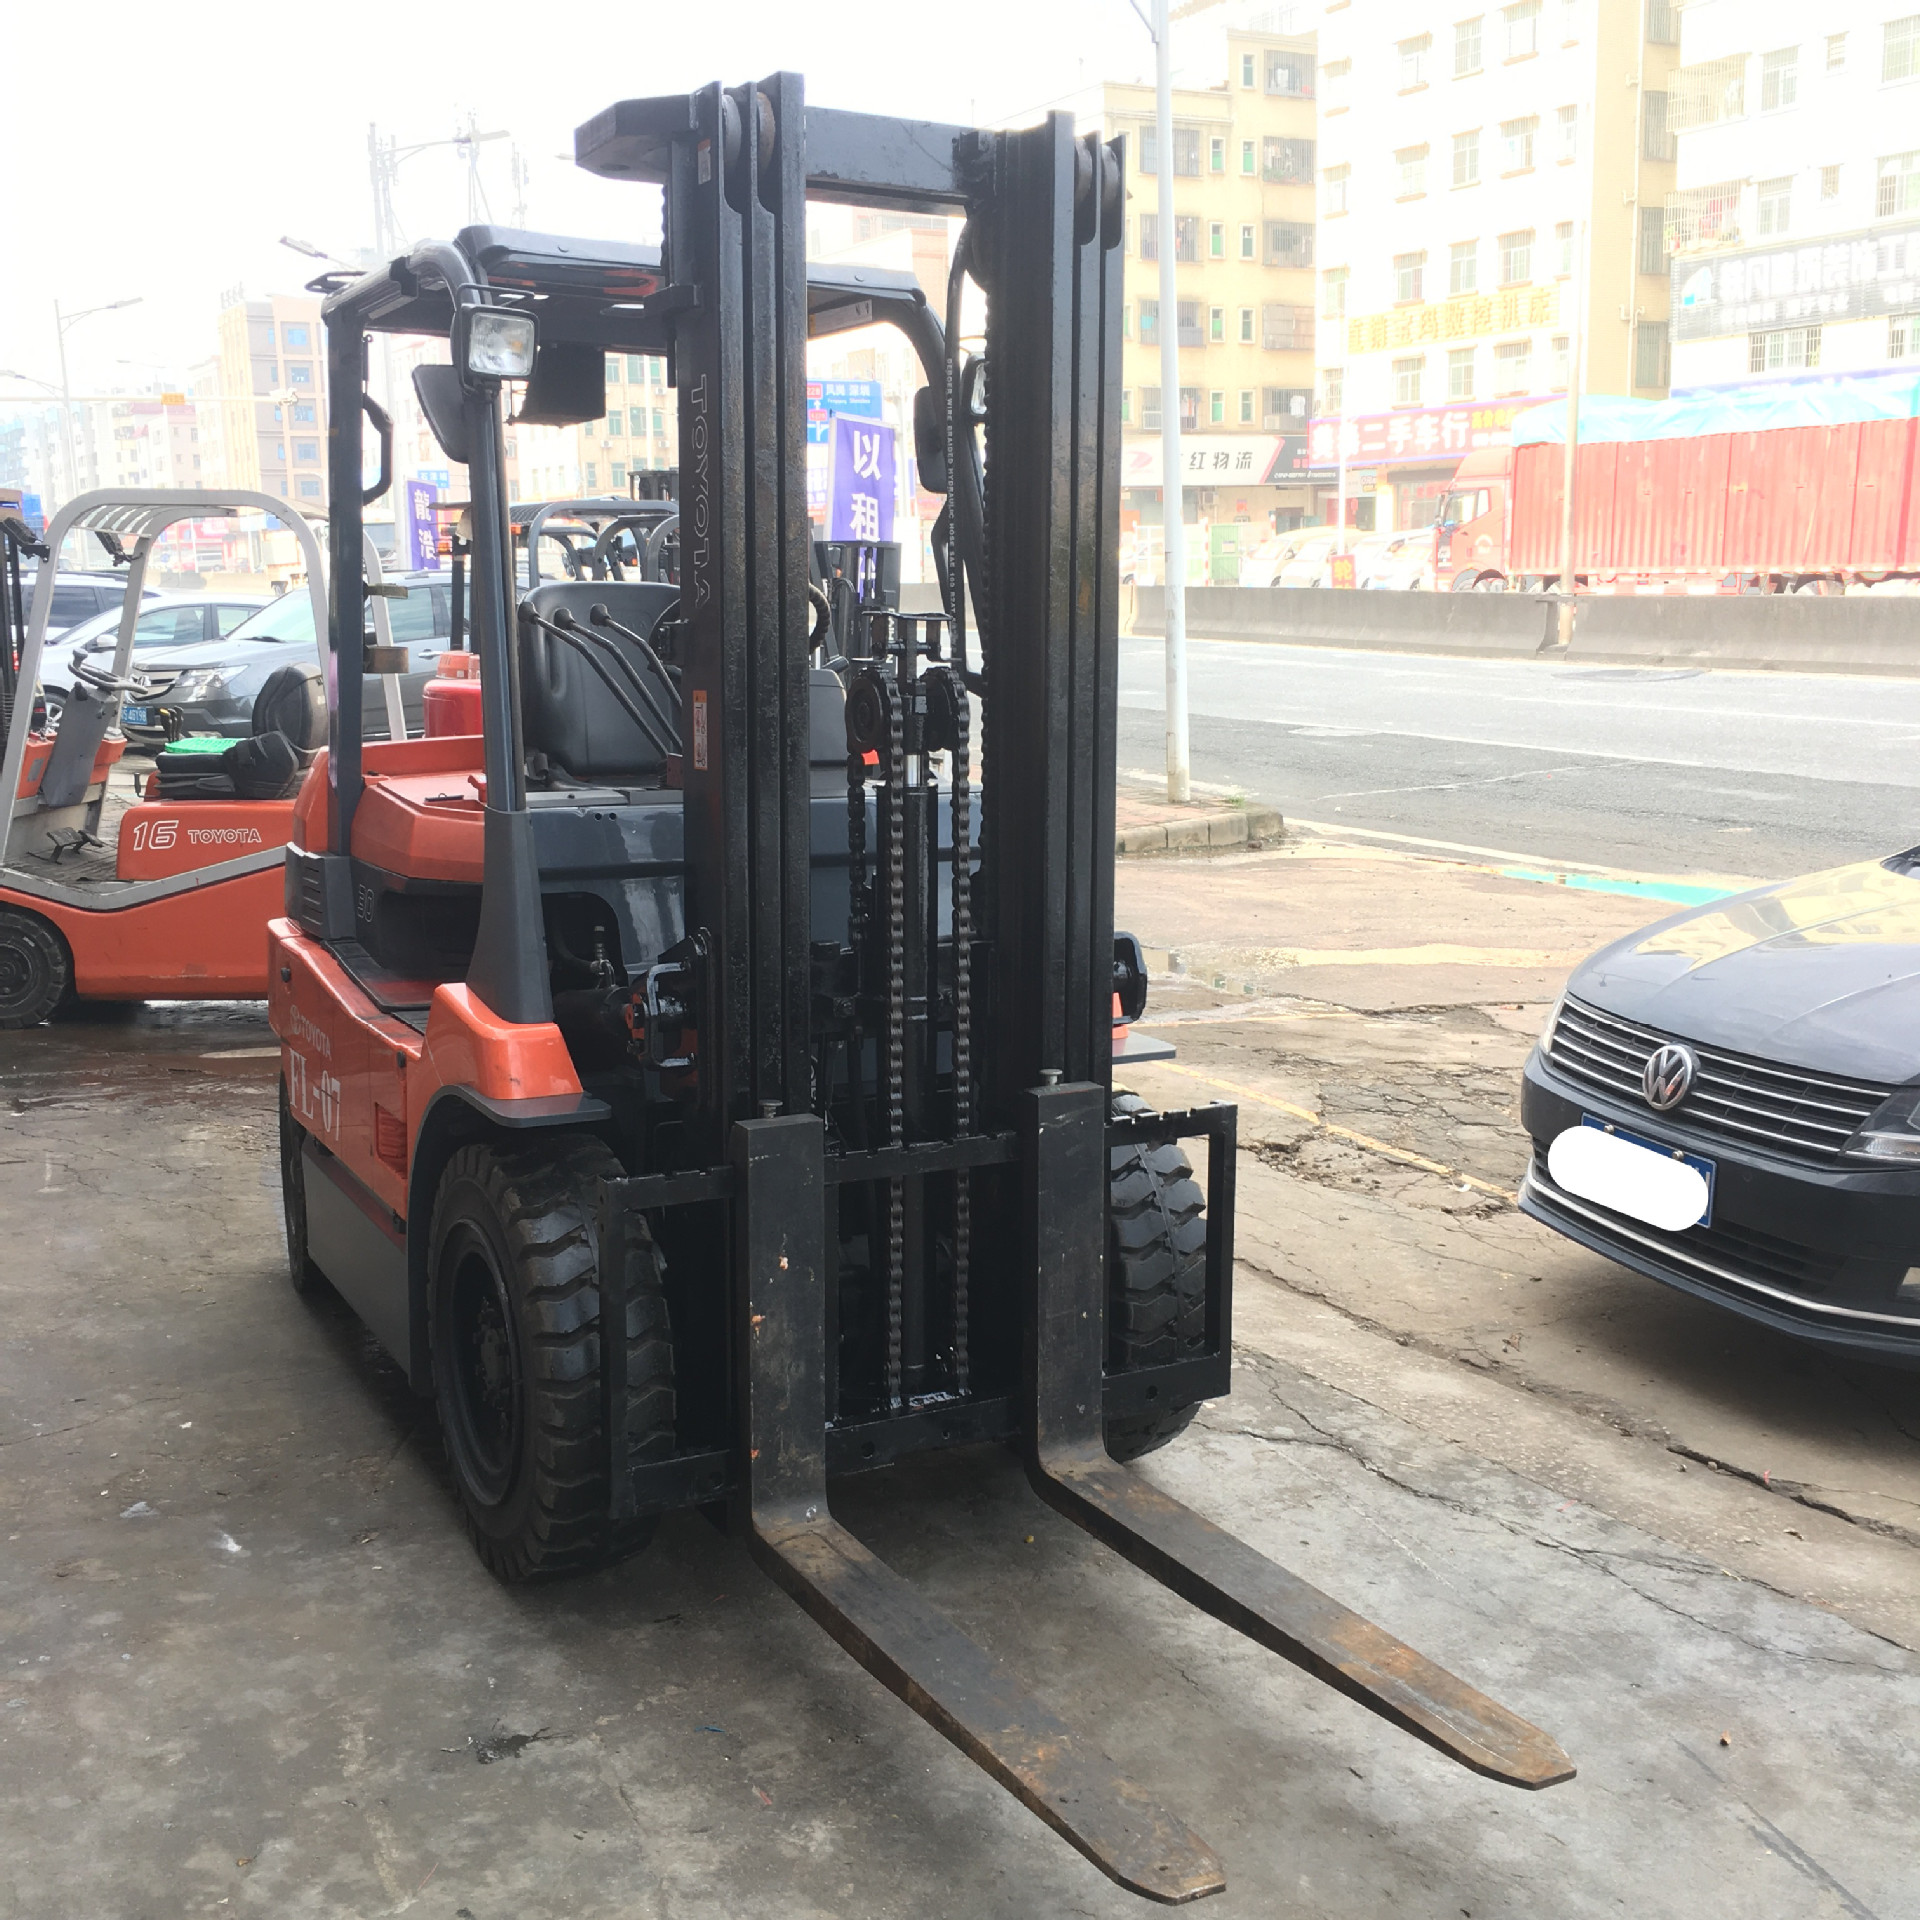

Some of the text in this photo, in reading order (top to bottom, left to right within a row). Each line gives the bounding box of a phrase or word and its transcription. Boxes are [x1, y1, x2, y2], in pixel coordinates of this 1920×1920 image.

[849, 384, 871, 396] 深圳
[1187, 450, 1254, 470] 红物流
[690, 373, 711, 609] TOYOTA
[133, 819, 262, 851] 16 TOYOTA
[300, 1015, 332, 1061] TOYOTA
[289, 1047, 341, 1141] FL-07
